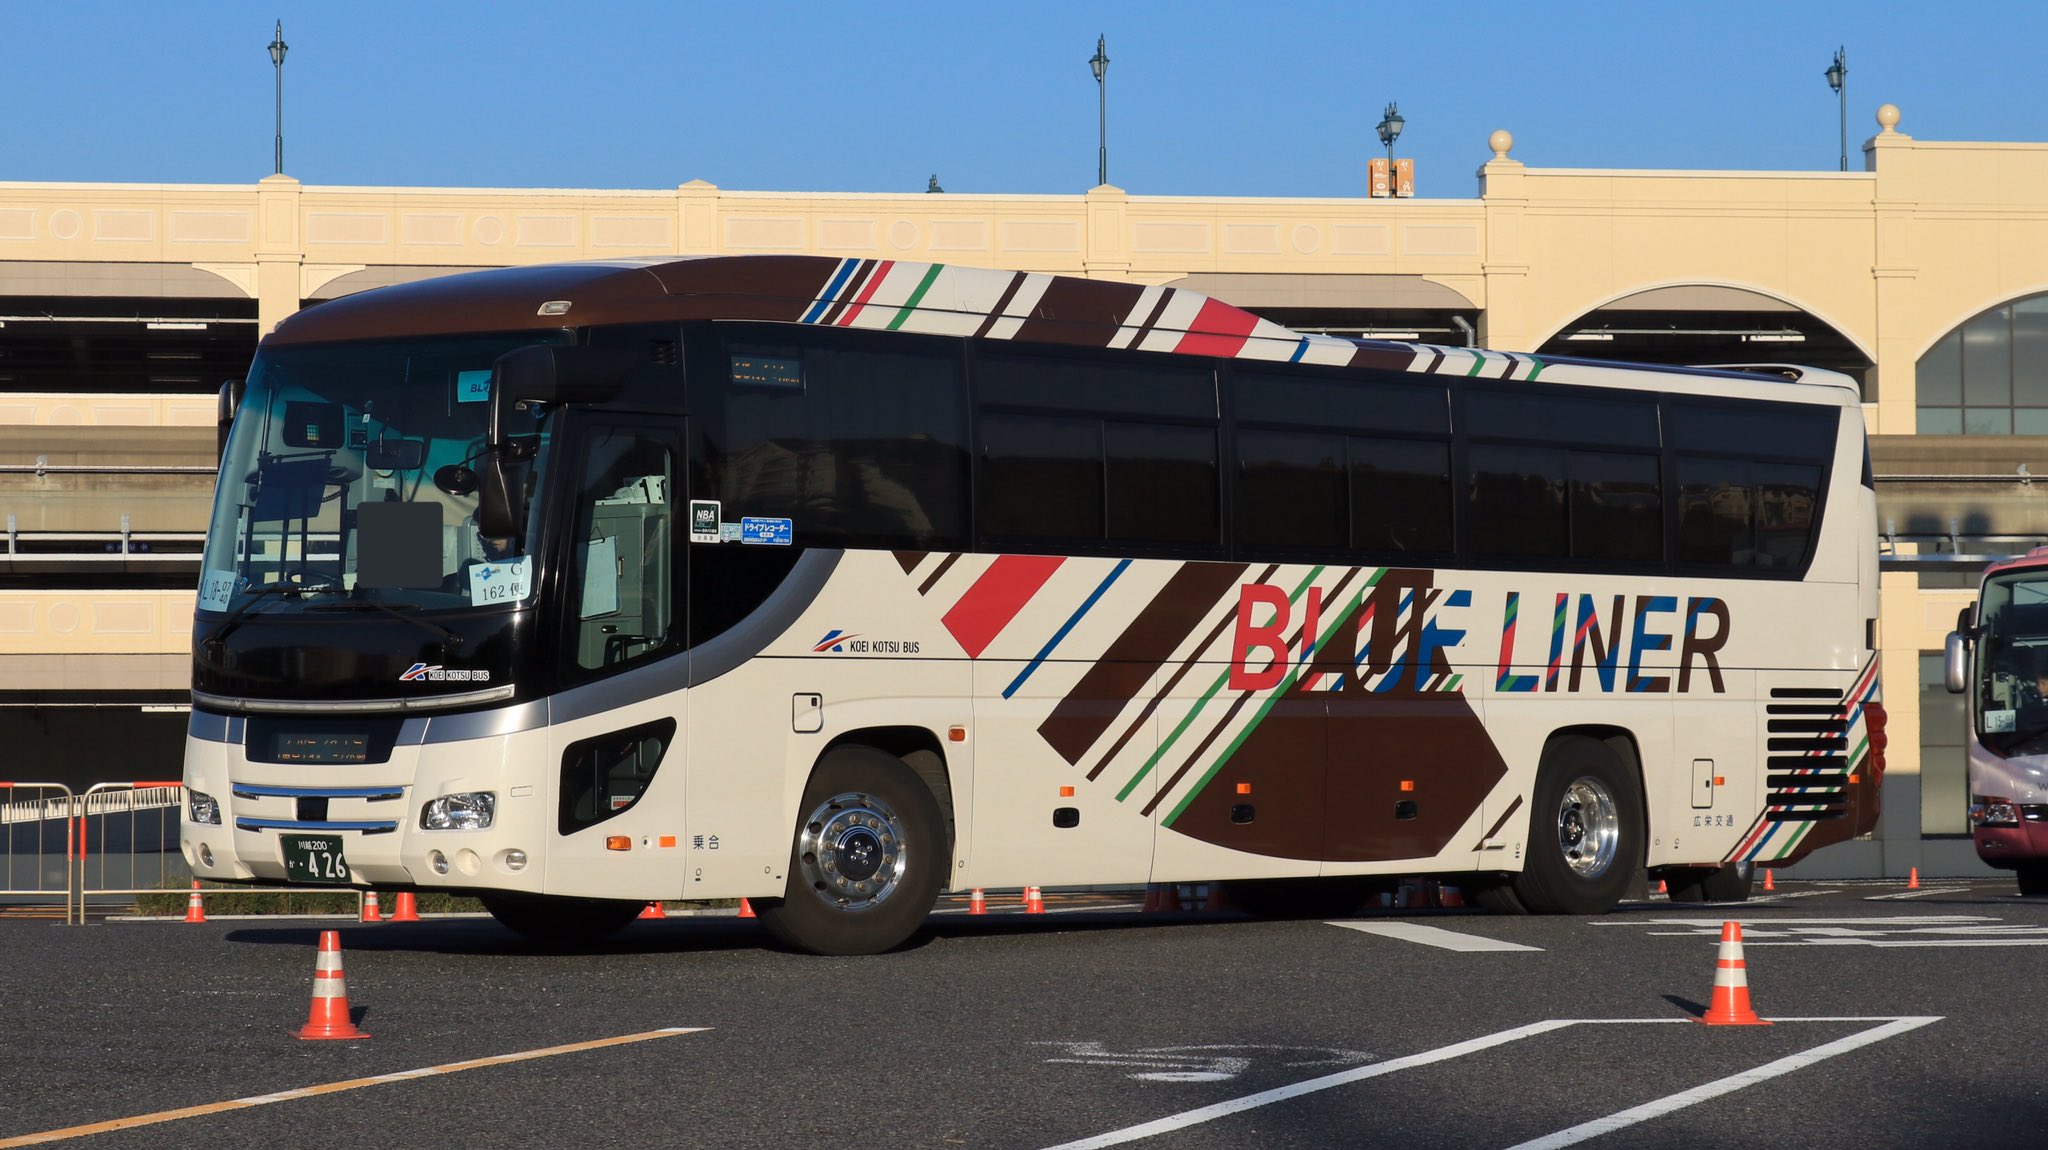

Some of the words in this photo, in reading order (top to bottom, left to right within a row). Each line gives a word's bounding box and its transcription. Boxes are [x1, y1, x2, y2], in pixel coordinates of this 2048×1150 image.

[697, 510, 715, 520] NBA
[744, 523, 789, 532] ドライブレコーダー
[1228, 583, 1471, 692] BLUE
[1495, 592, 1731, 693] LINER
[850, 640, 869, 652] KOEI
[872, 641, 900, 653] KOTSU
[903, 641, 920, 653] BUS
[429, 670, 445, 680] KOEI
[446, 670, 471, 680] KOTSU
[472, 670, 489, 680] BUS
[1693, 814, 1734, 827] 広栄交通
[693, 834, 720, 850] 乗合
